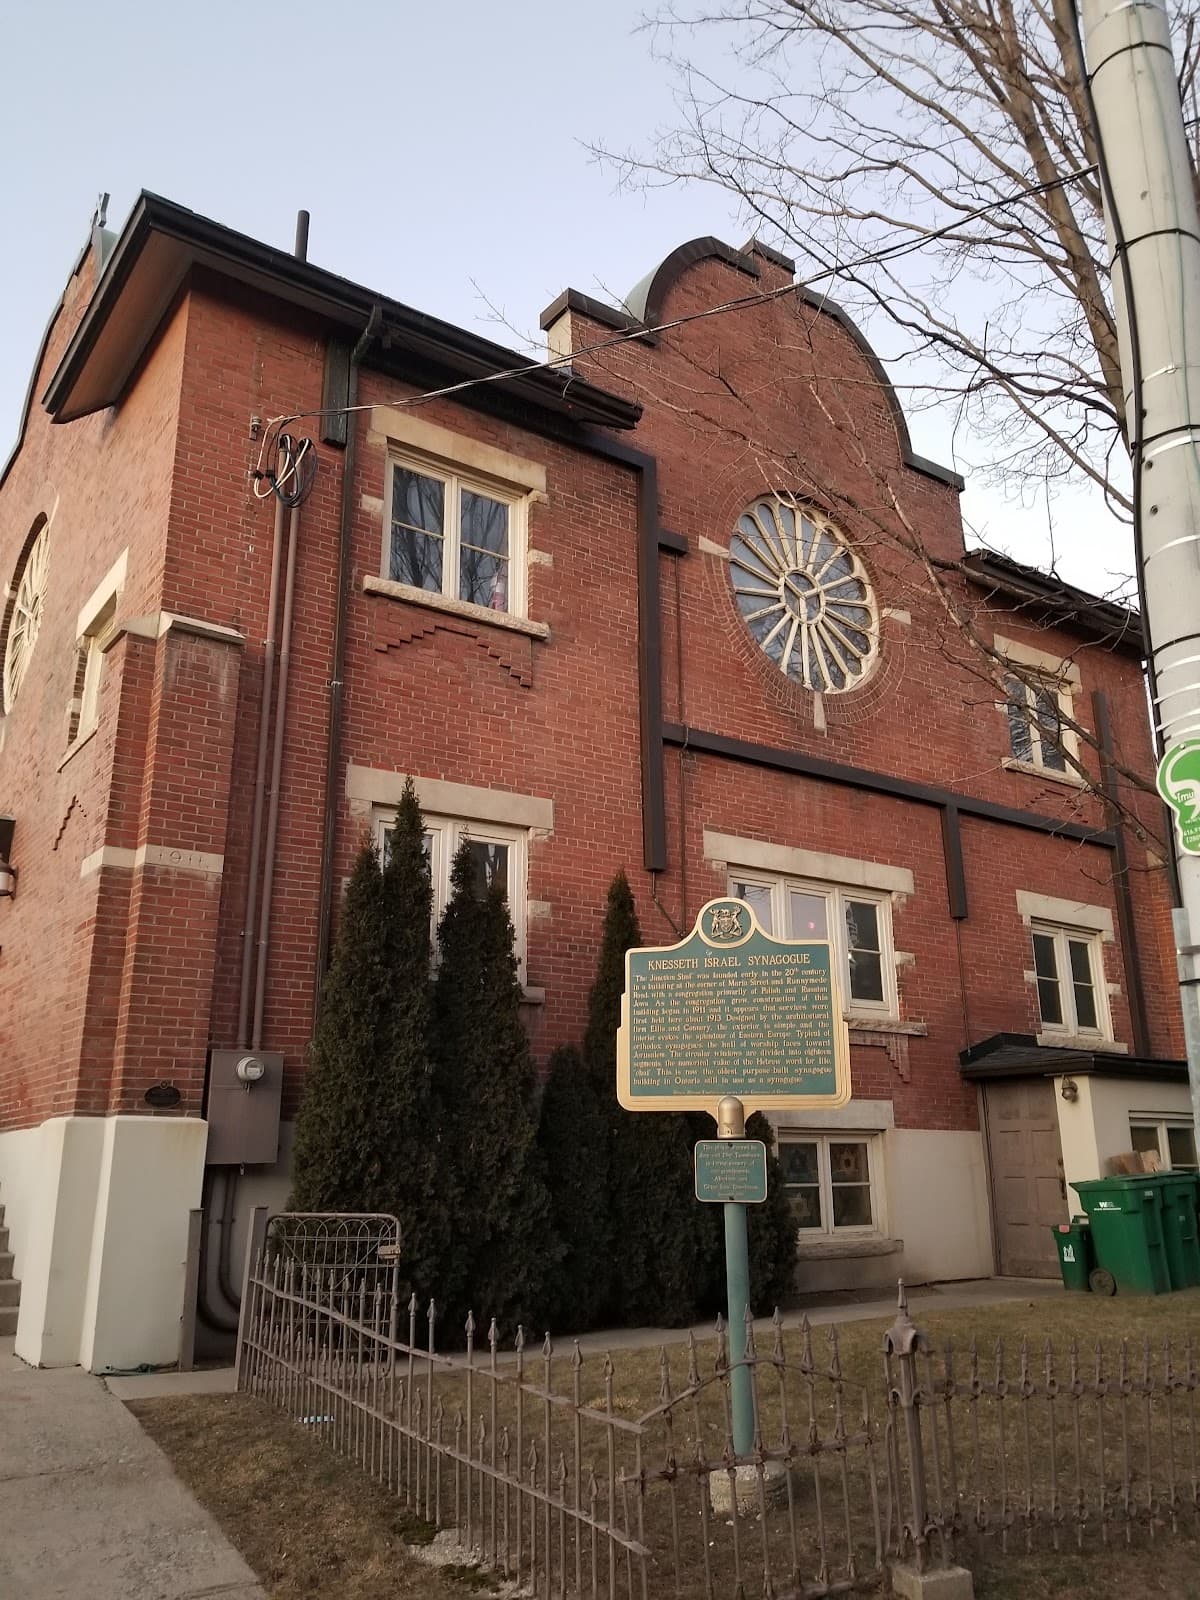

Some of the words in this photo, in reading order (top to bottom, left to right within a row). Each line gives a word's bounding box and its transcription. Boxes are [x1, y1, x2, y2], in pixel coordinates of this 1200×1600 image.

[648, 959, 698, 970] KNESSETH
[704, 957, 741, 967] ISRAEL
[748, 954, 811, 965] SYNAGOGUE
